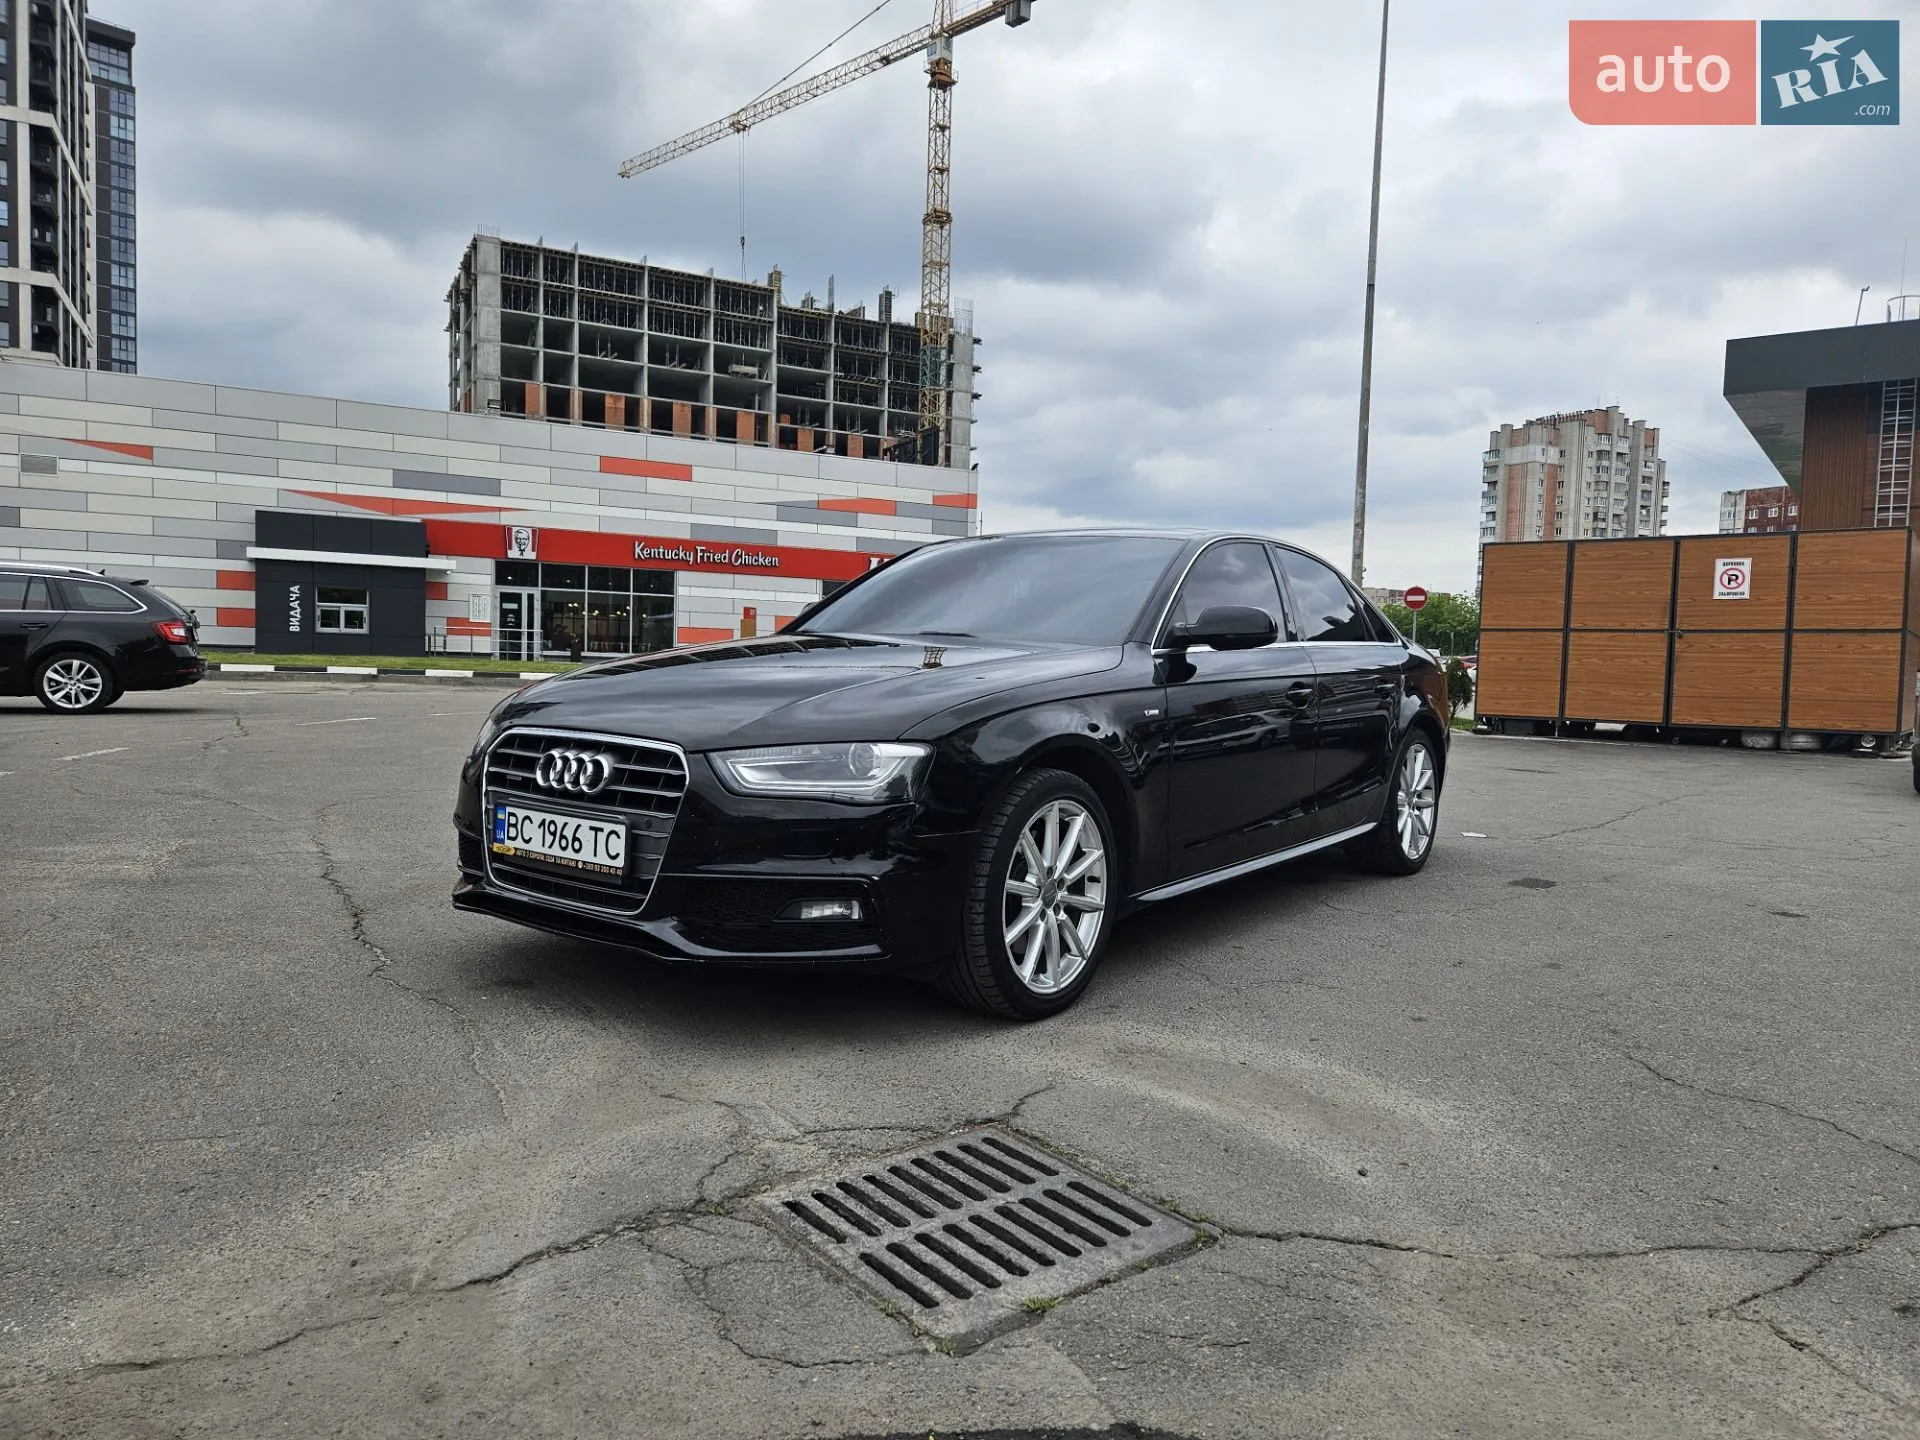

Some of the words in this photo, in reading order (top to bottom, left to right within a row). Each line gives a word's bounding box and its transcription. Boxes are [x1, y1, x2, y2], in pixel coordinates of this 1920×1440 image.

[634, 541, 694, 565] Kentucky
[696, 546, 729, 564] Fried
[731, 548, 780, 567] Chicken
[289, 585, 300, 632] ВИДАЧА
[496, 830, 505, 840] UA
[507, 812, 533, 844] BC
[538, 818, 582, 854] 1966
[589, 826, 621, 860] TC
